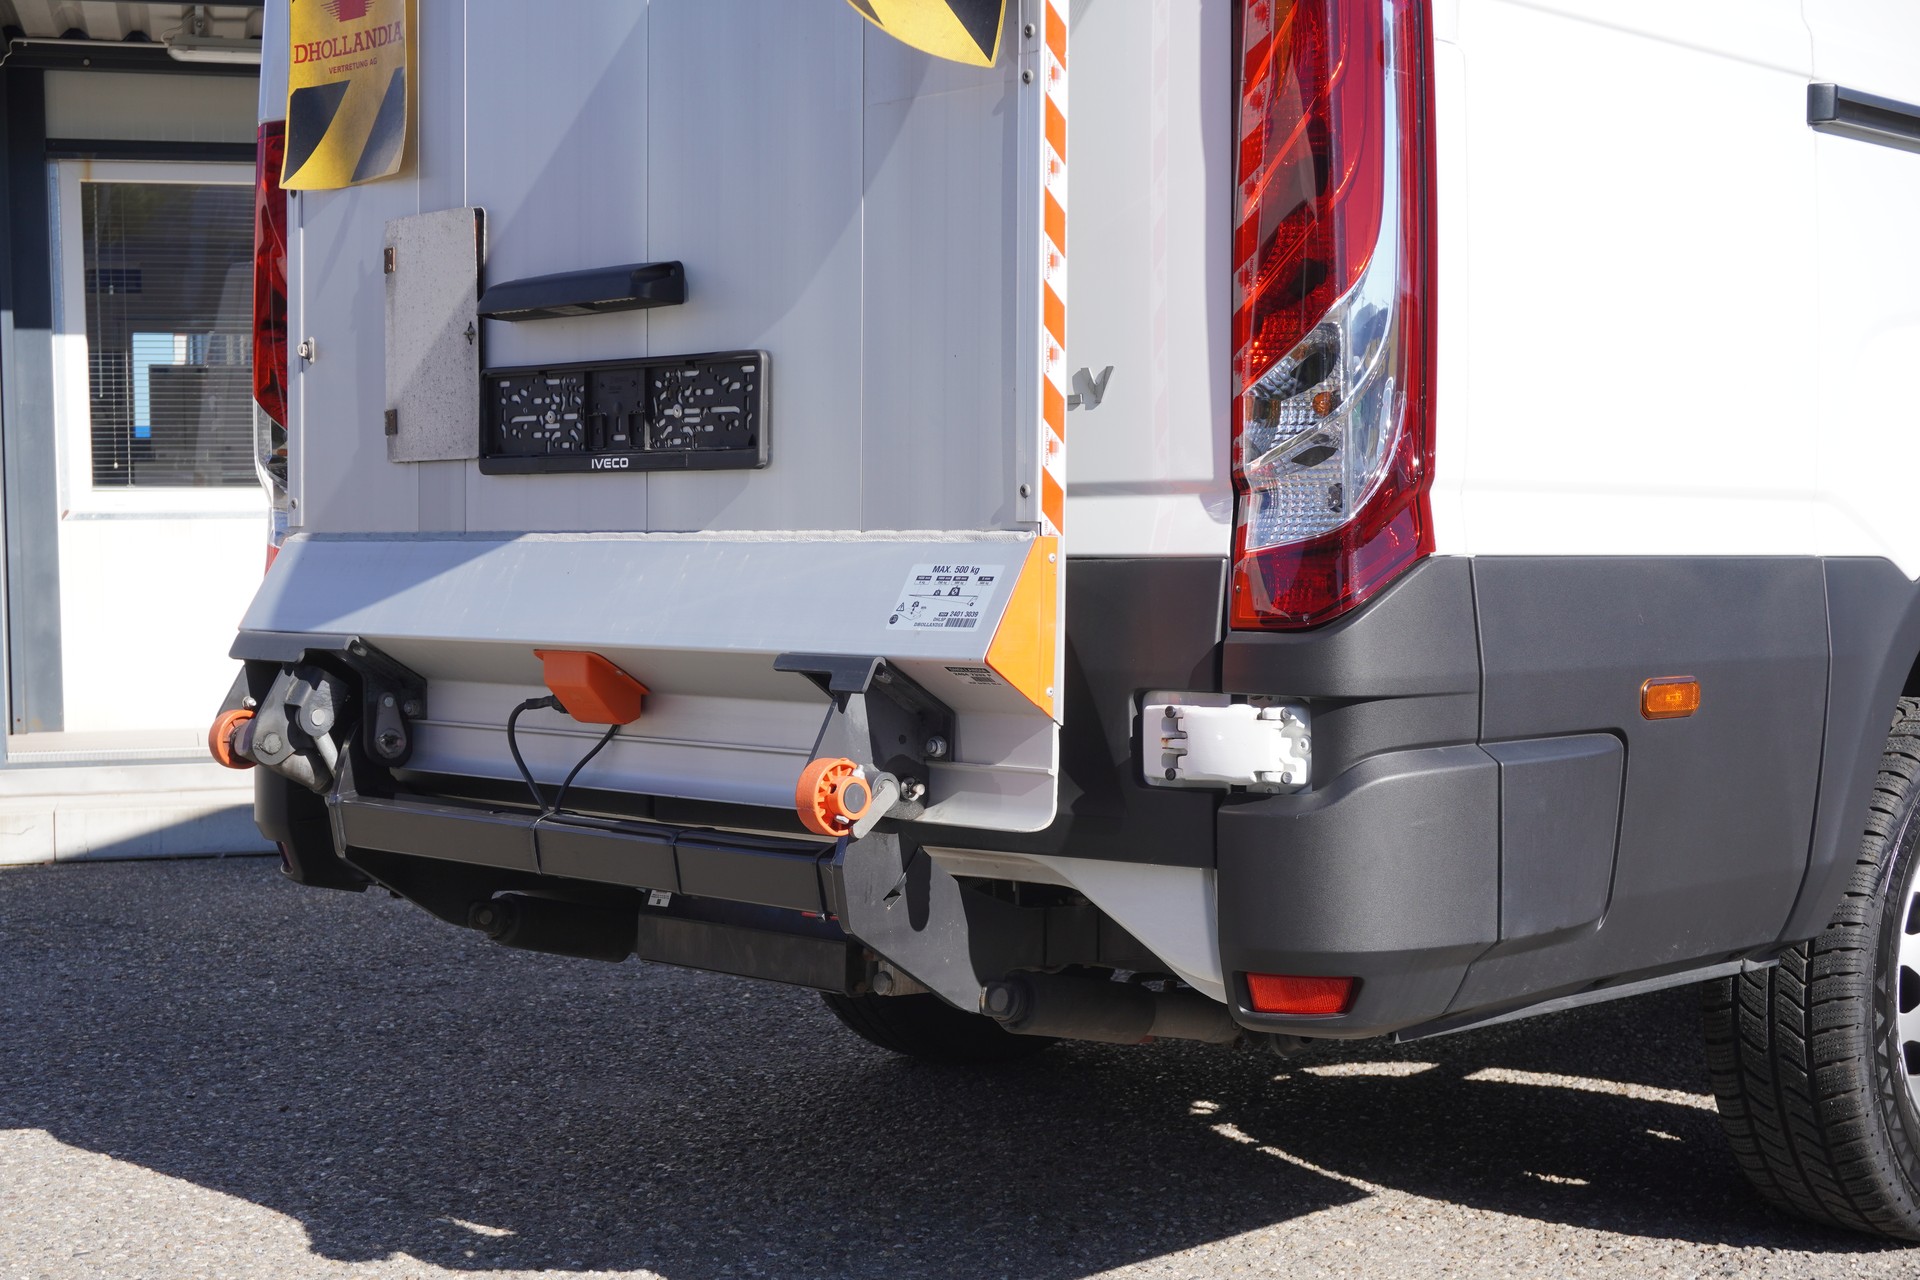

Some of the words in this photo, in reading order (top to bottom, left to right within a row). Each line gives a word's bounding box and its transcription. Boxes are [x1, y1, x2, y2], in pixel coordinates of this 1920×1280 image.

[294, 21, 403, 64] DHOLLANDIA
[328, 59, 368, 74] VERTRETUNG
[369, 57, 378, 65] AG
[591, 457, 629, 469] IVECO
[932, 565, 952, 574] MAX.
[954, 565, 969, 574] 500
[970, 565, 981, 575] kg
